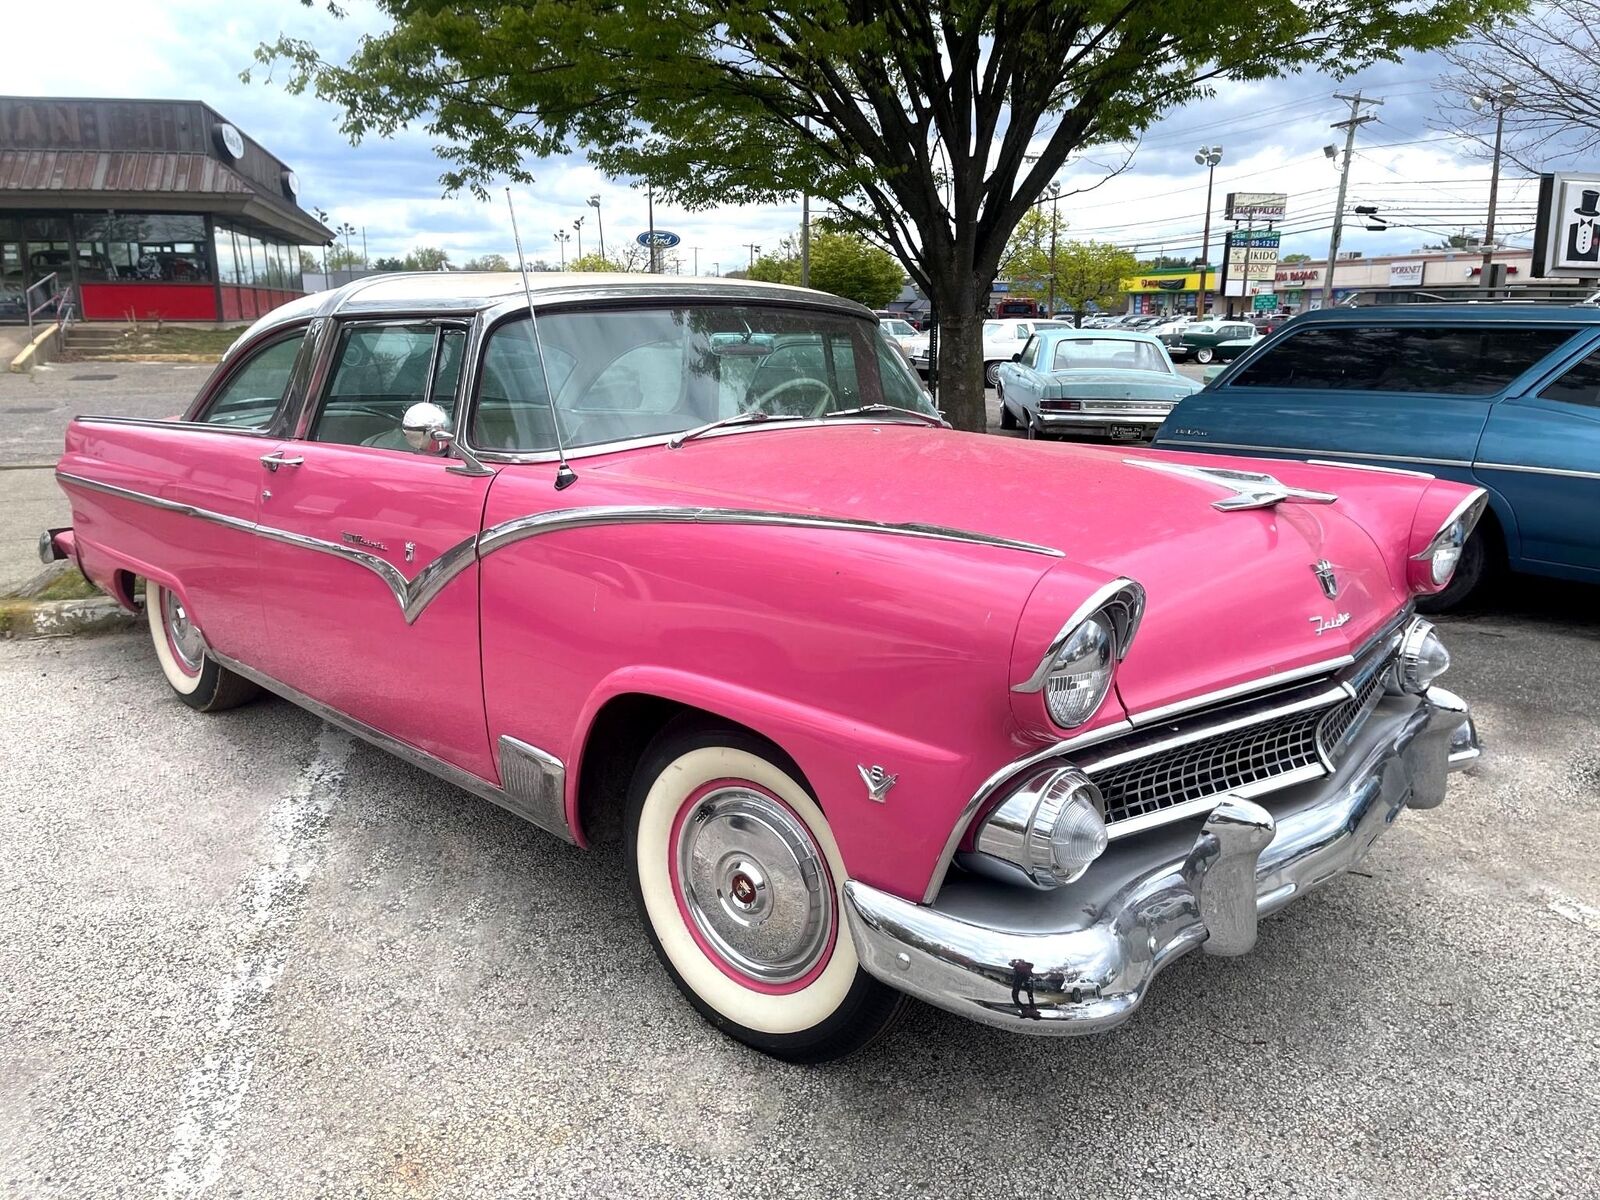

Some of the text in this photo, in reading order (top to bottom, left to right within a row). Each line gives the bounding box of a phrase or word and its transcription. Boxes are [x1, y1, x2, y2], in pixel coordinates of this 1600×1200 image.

[1258, 207, 1283, 215] PALACE
[645, 233, 672, 245] Ford
[1246, 251, 1277, 261] IKIDO
[1391, 265, 1421, 275] WORKNET
[1290, 270, 1319, 281] BAZAAR
